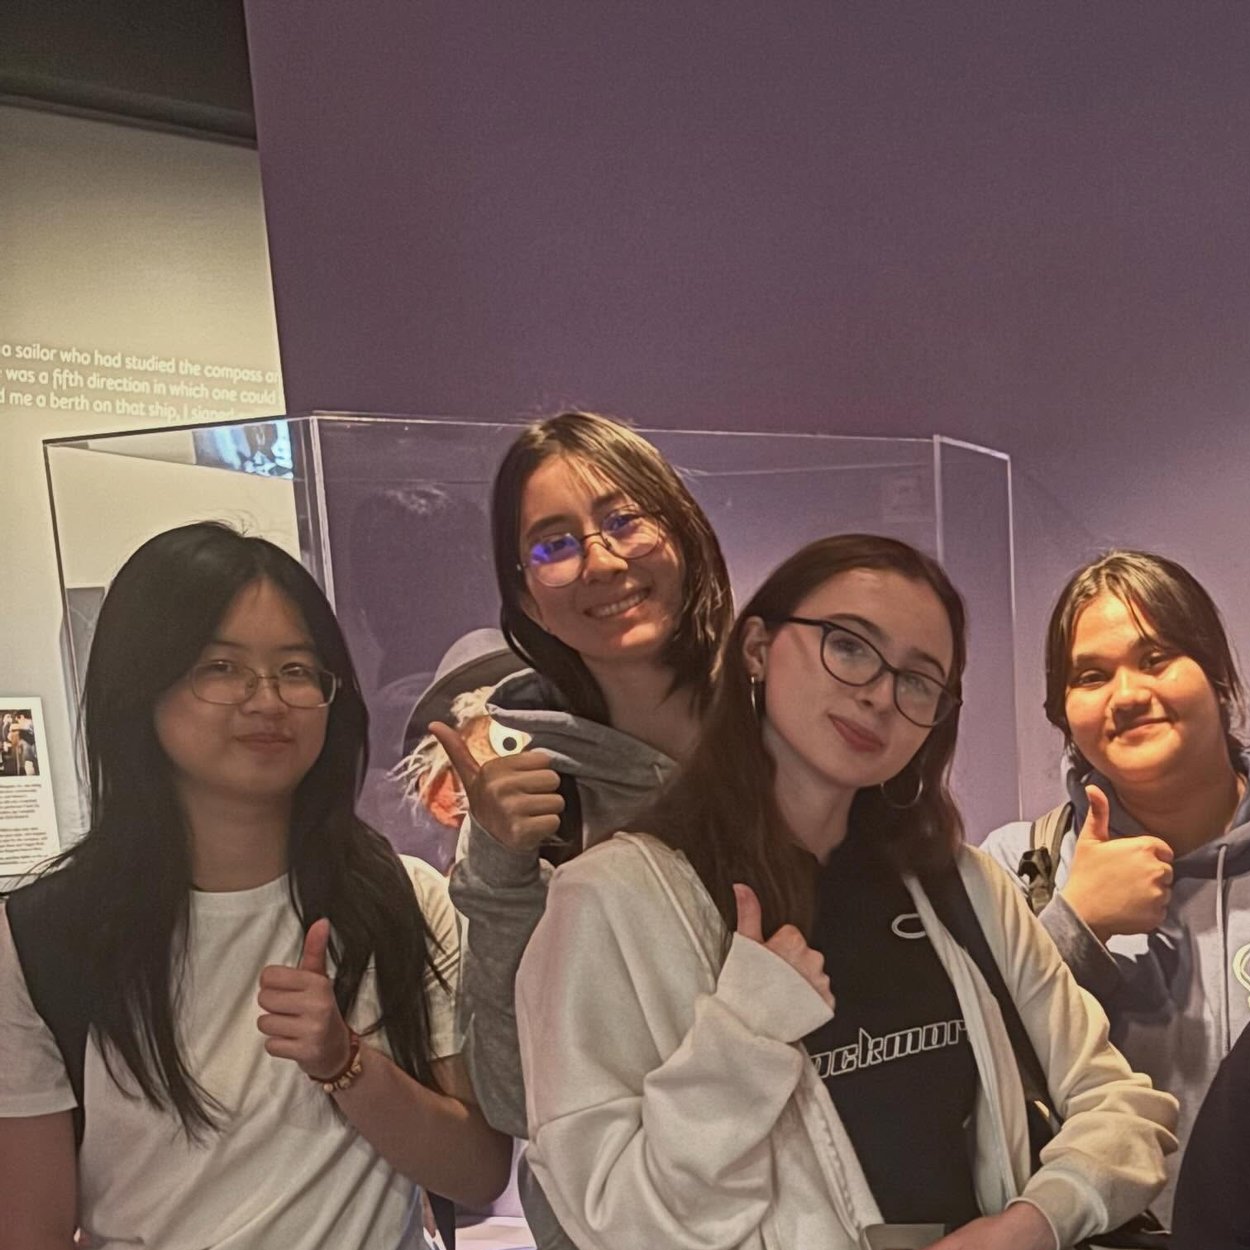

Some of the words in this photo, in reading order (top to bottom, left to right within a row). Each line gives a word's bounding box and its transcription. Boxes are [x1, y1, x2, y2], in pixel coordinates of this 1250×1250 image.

[2, 344, 12, 357] a
[15, 343, 57, 361] sailor
[60, 346, 91, 365] who
[94, 349, 122, 368] had
[125, 355, 176, 373] studied
[179, 358, 201, 376] the
[204, 365, 263, 384] compass
[6, 368, 35, 383] was
[39, 371, 49, 384] a
[52, 368, 84, 390] fifth
[87, 372, 150, 394] direction
[153, 379, 166, 395] in
[169, 381, 209, 399] which
[212, 388, 238, 402] one
[240, 389, 276, 405] could
[9, 392, 33, 406] me
[36, 394, 47, 408] a
[50, 391, 90, 411] berth
[93, 399, 112, 413] on
[115, 398, 145, 416] that
[148, 401, 181, 424] ship,
